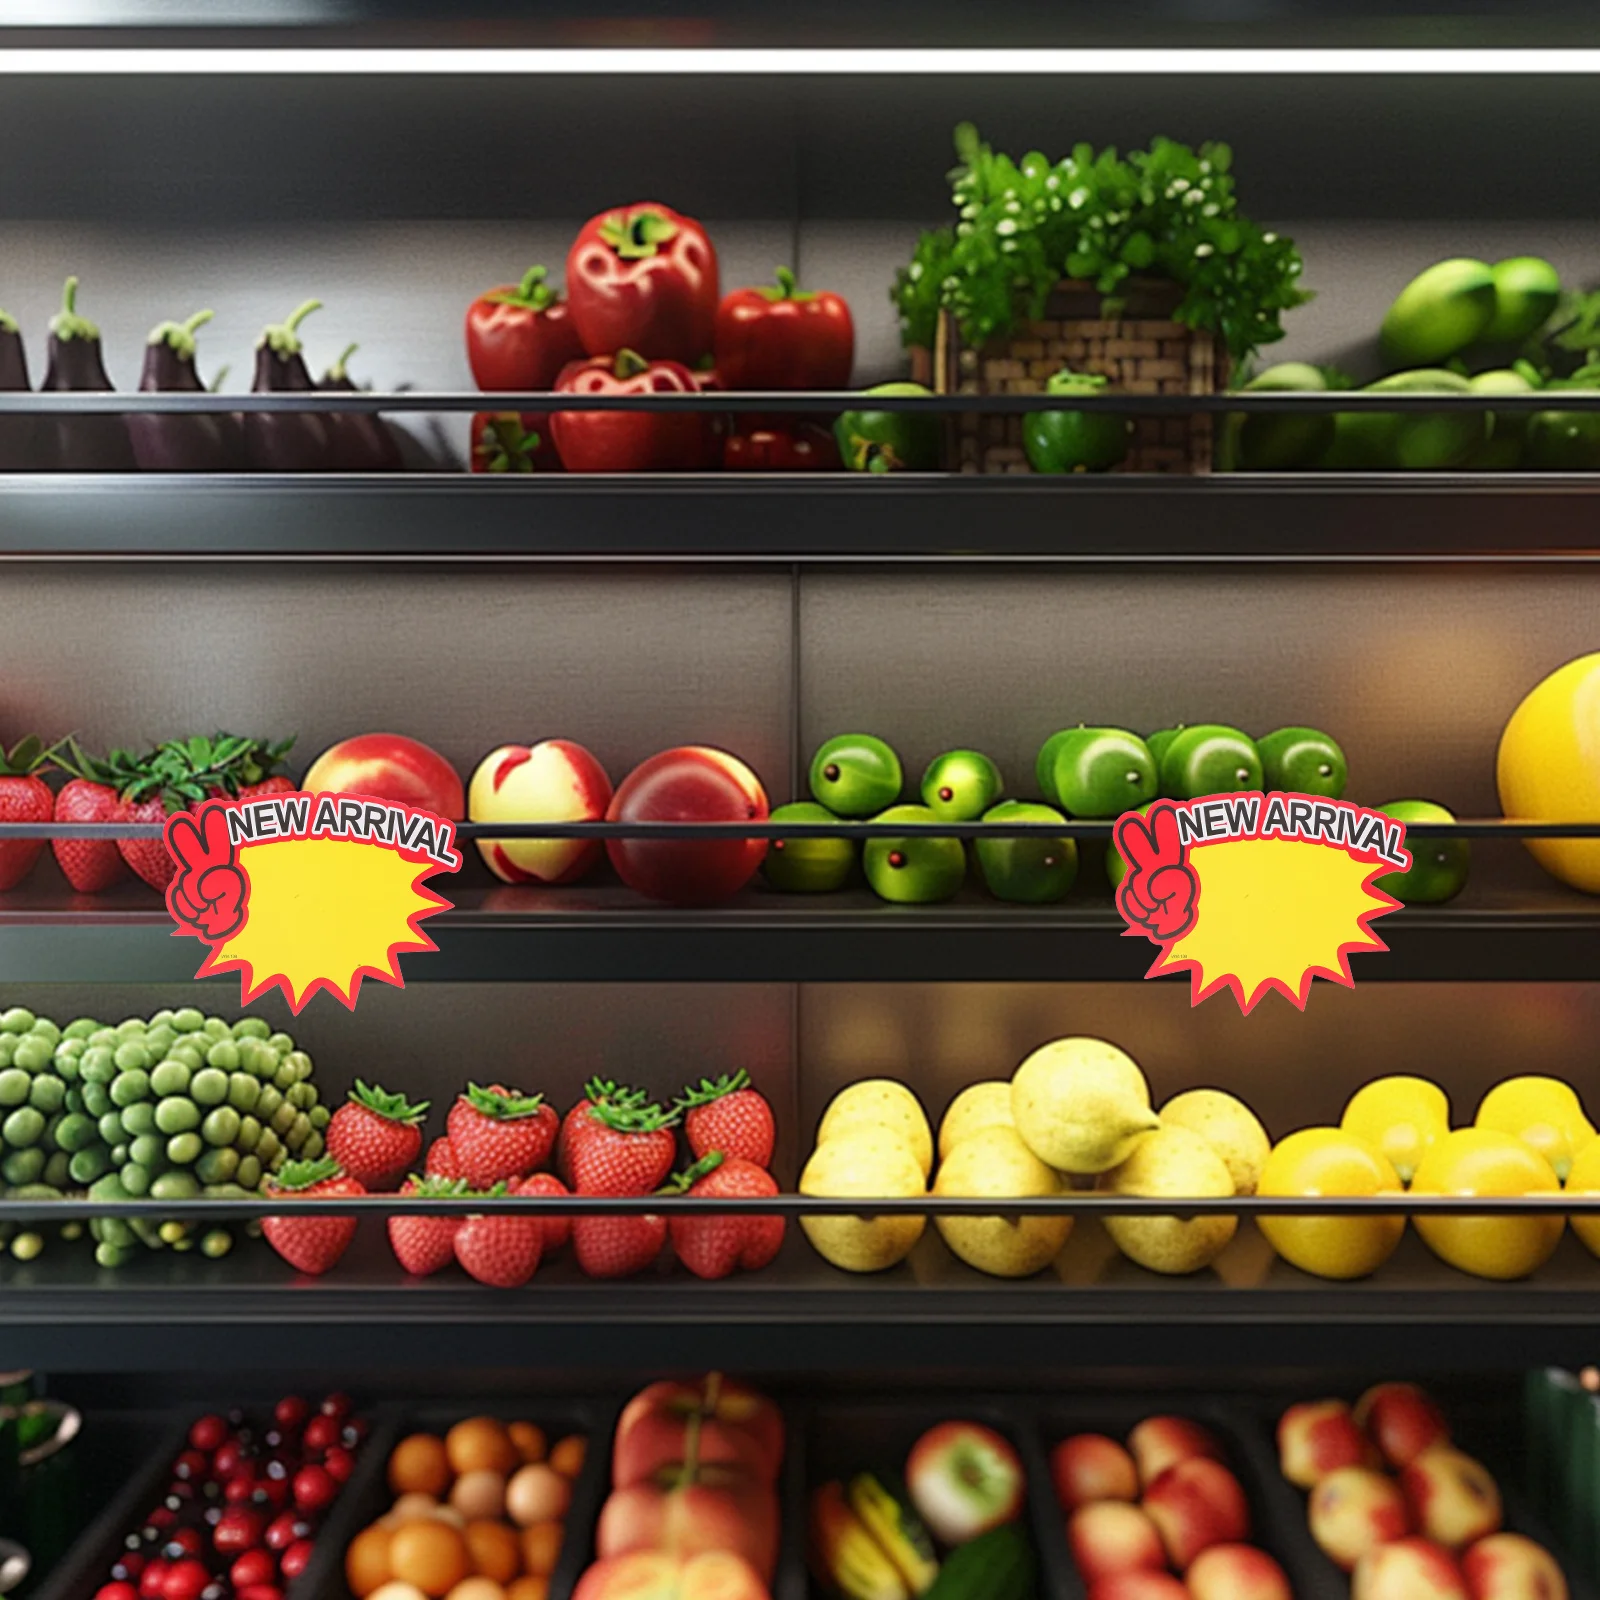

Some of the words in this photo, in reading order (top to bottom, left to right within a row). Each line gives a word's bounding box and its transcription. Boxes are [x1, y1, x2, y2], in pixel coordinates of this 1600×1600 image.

[228, 800, 308, 842] NEW
[314, 800, 455, 864] ARRIVAL
[1178, 800, 1258, 842] NEW
[1264, 800, 1405, 864] ARRIVAL
